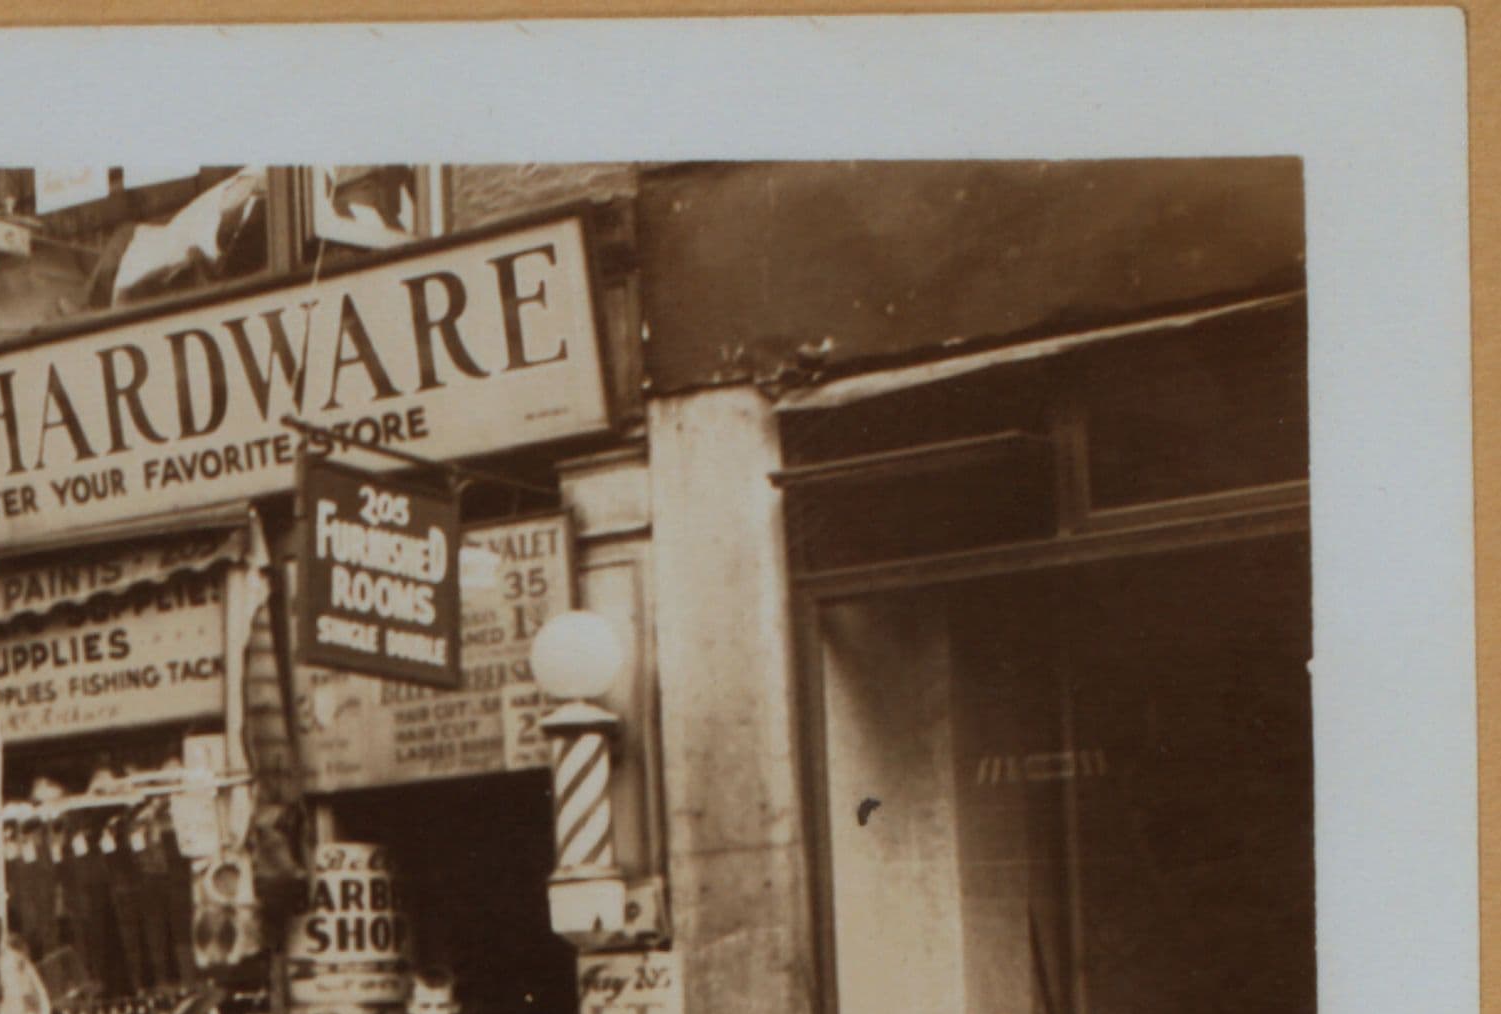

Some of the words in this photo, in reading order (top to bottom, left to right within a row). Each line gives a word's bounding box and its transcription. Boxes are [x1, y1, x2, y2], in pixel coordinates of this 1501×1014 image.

[50, 466, 127, 504] YOUR
[143, 433, 293, 488] FAVORITE
[306, 406, 429, 458] STORE
[358, 484, 411, 527] 205
[3, 560, 123, 612] PAINTS
[330, 563, 438, 627] ROOMS
[502, 566, 549, 601] 35
[69, 664, 161, 697] FISHING
